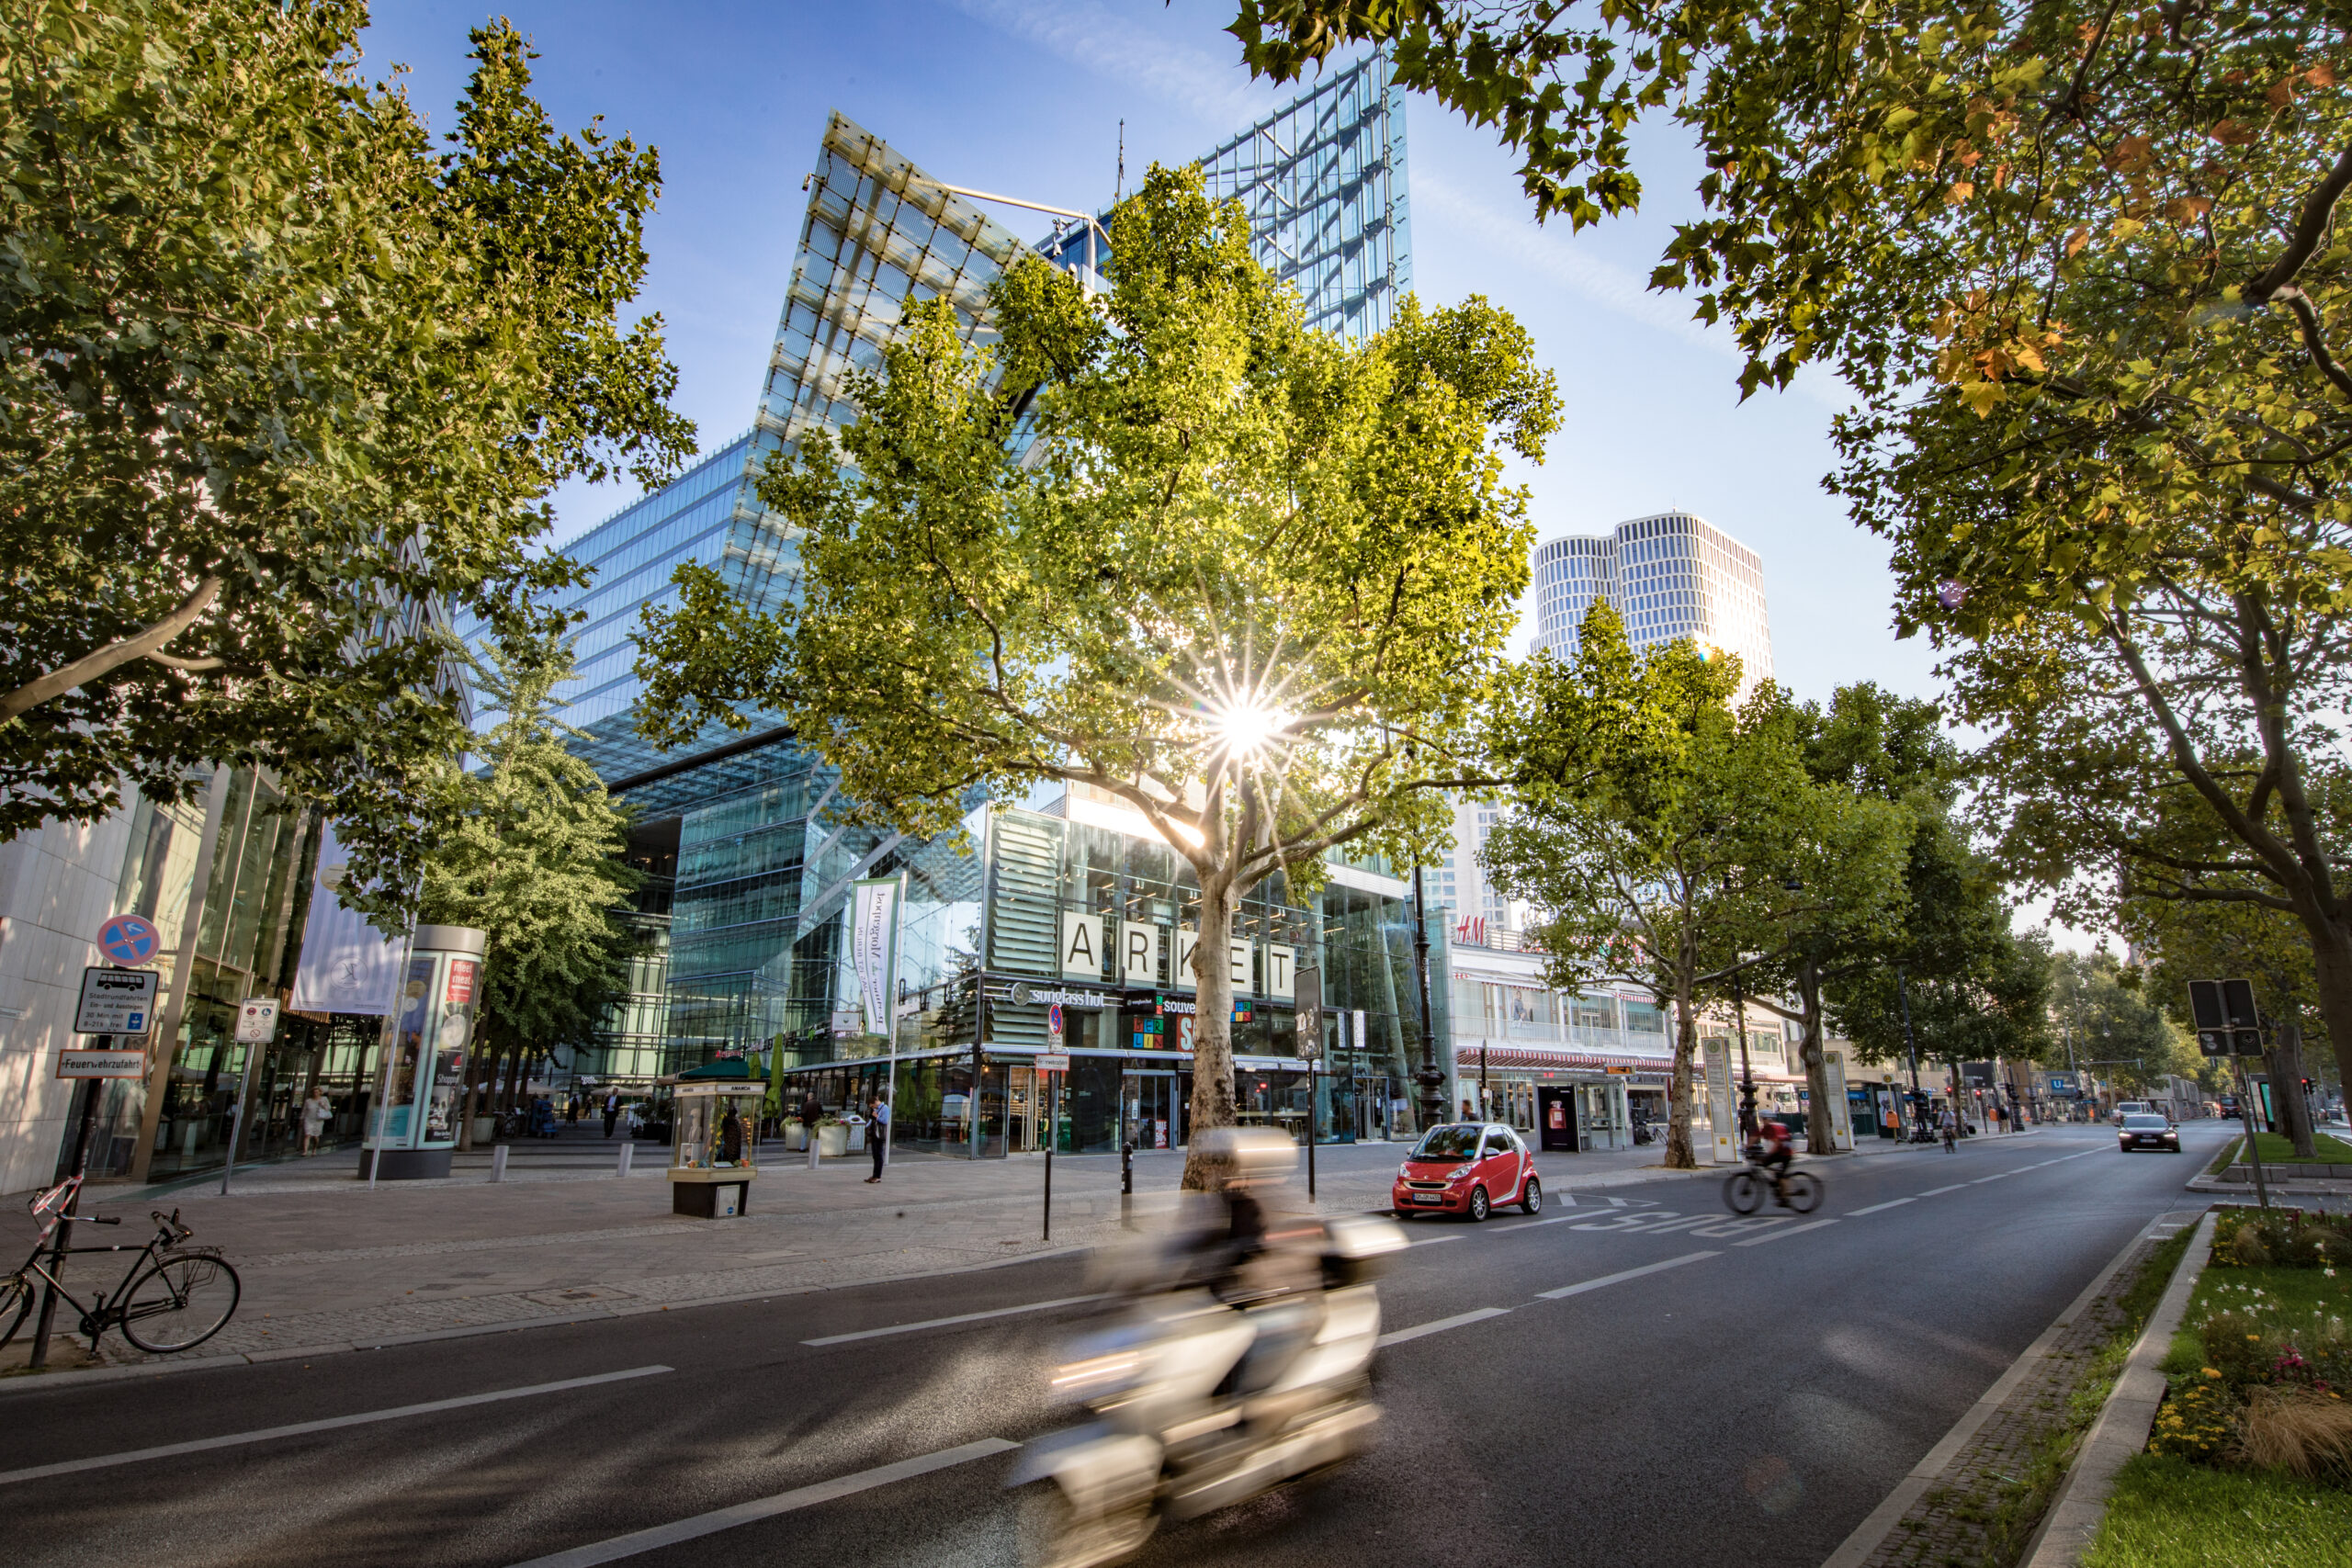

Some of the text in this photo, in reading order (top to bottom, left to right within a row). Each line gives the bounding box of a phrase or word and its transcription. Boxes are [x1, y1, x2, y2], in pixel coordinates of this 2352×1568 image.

[1457, 914, 1485, 945] H&M
[1068, 922, 1290, 988] ARKET
[89, 993, 148, 1001] Stadtrundfahrten
[1032, 987, 1104, 1008] sunglass hut
[1163, 1000, 1195, 1014] souve
[2053, 1079, 2063, 1089] U
[1568, 1211, 1798, 1238] BUS
